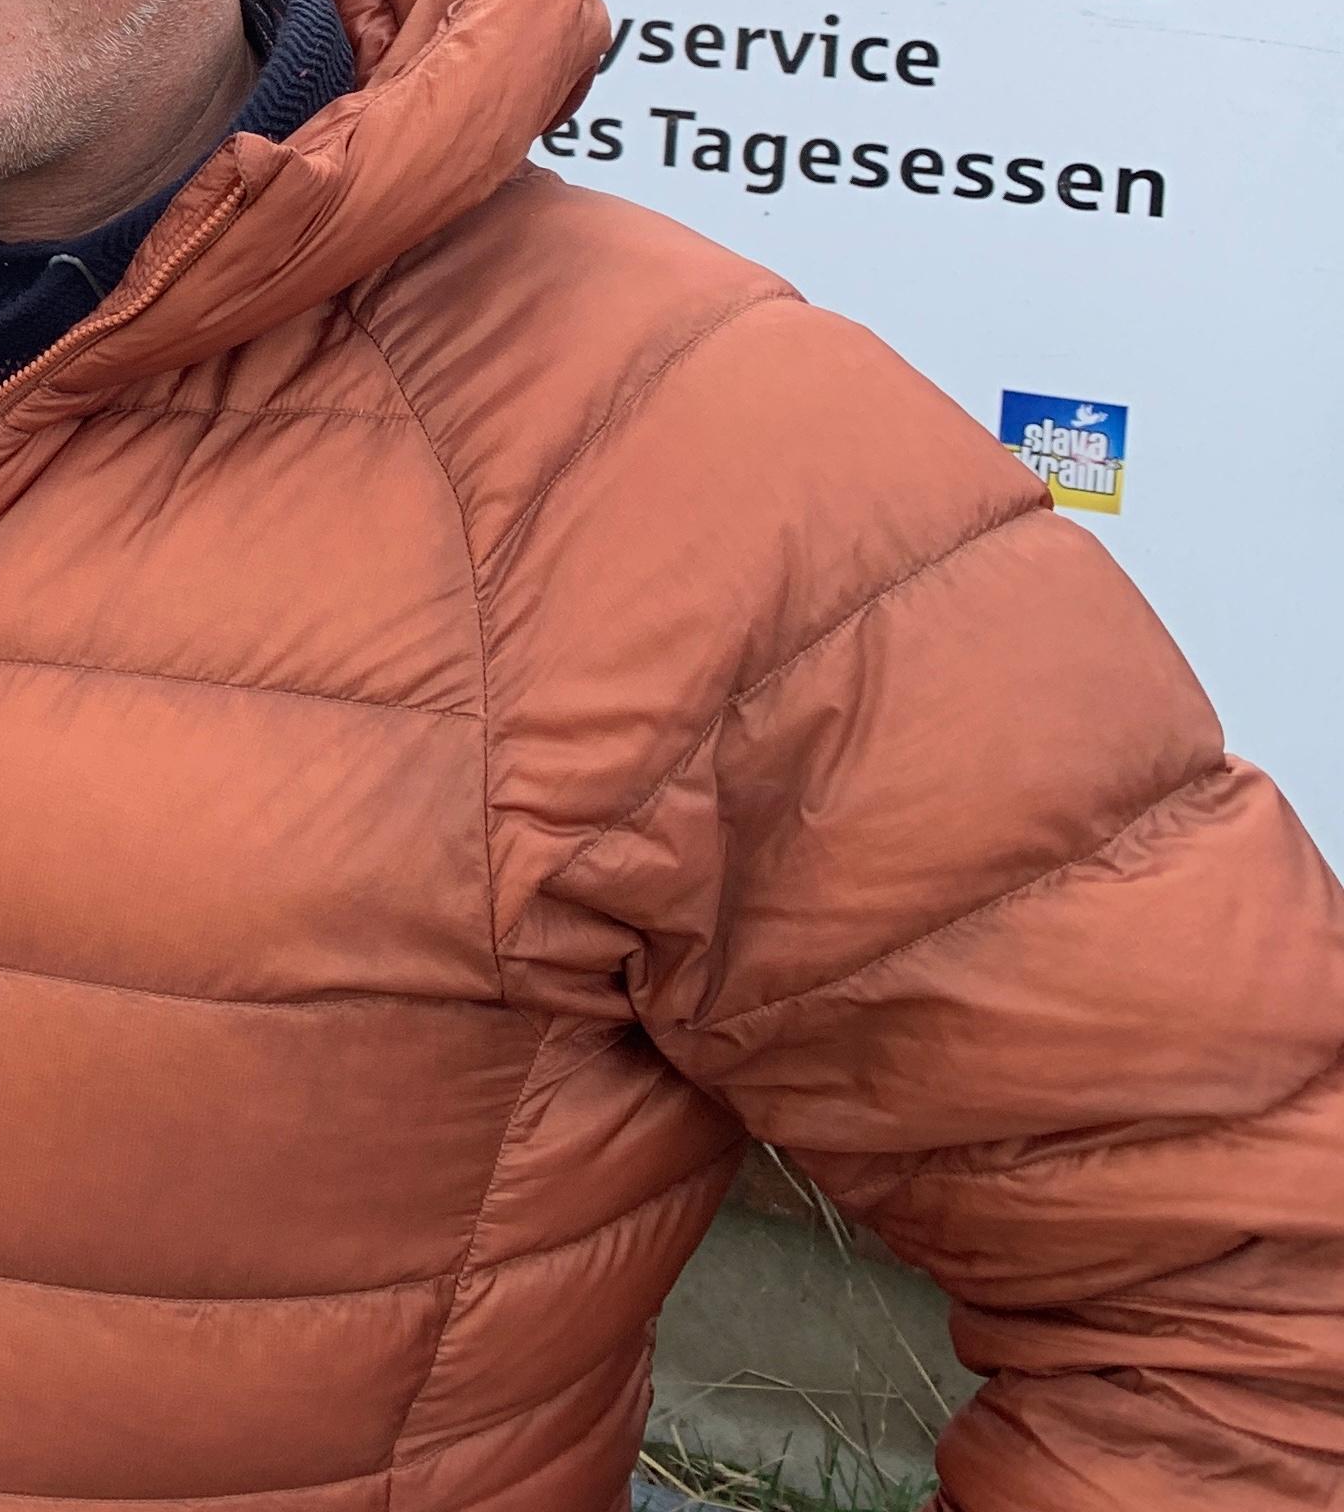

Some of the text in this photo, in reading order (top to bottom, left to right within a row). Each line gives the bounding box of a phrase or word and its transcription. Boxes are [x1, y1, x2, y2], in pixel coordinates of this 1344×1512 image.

[596, 14, 941, 87] yservice
[650, 107, 1166, 219] Tagesessen
[1023, 418, 1109, 464] slava
